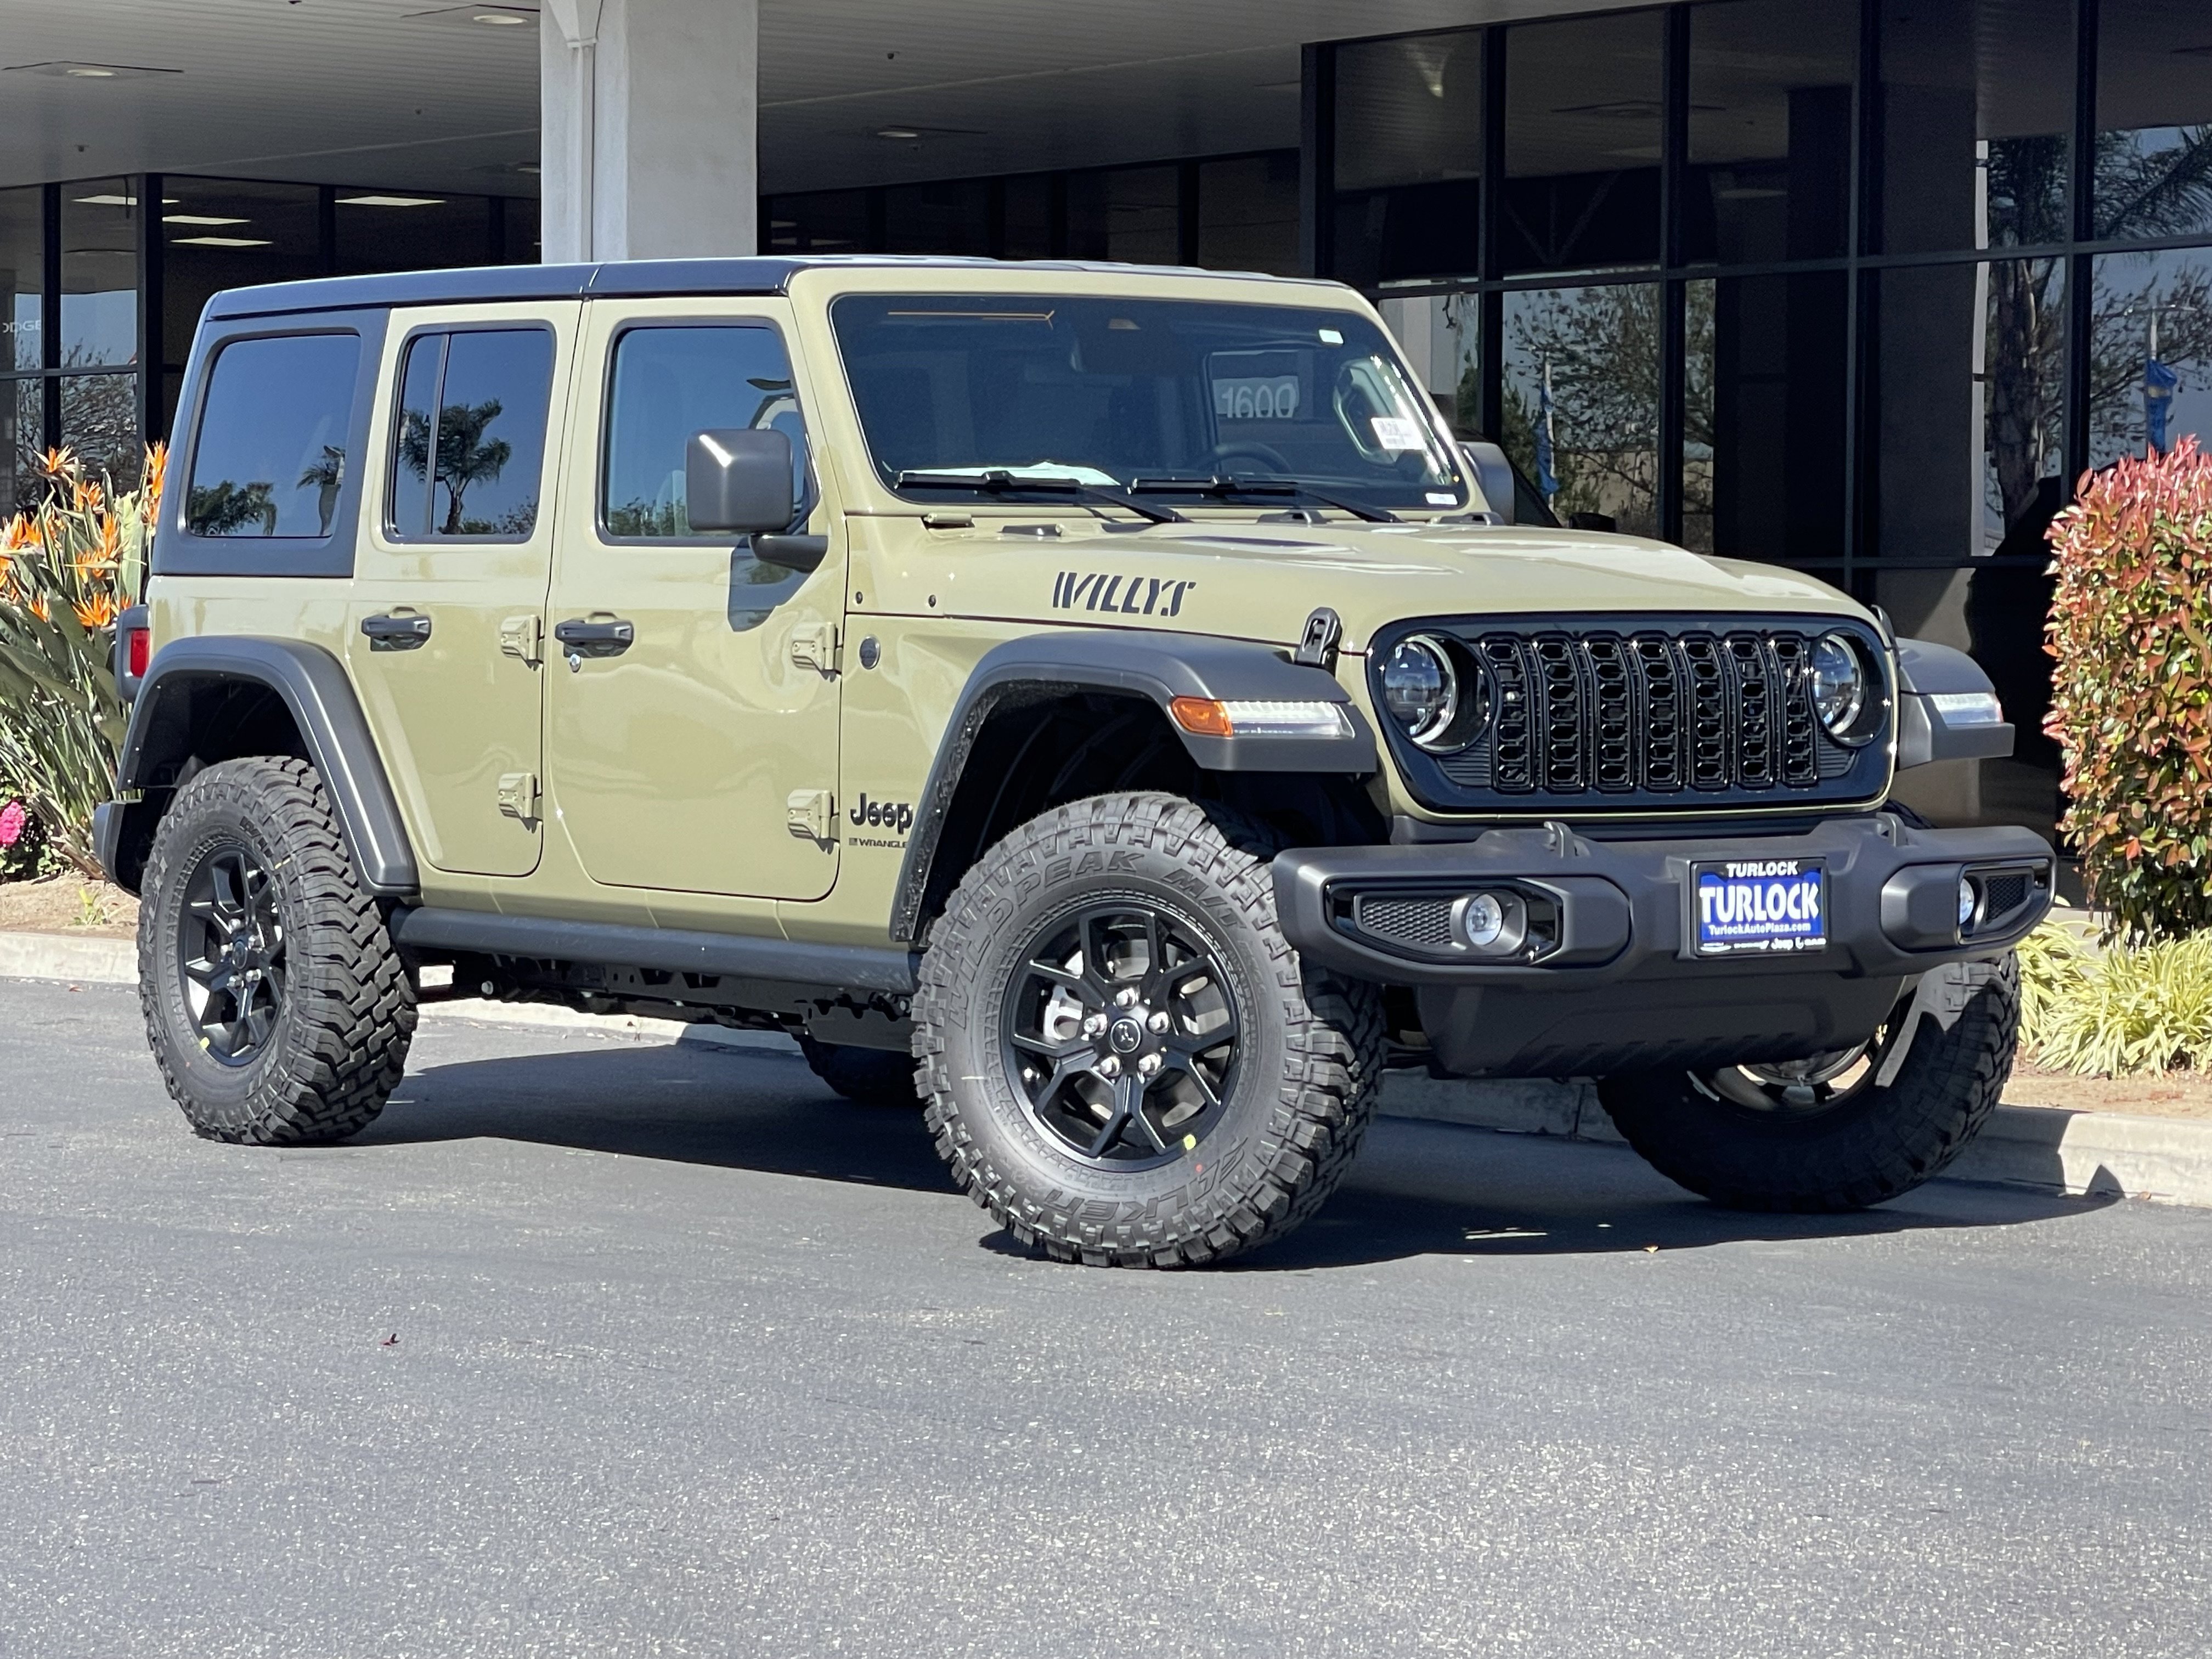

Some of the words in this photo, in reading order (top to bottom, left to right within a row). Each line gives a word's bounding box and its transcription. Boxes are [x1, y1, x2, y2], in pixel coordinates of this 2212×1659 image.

[1222, 383, 1296, 419] 1600
[1053, 572, 1197, 617] WILLYS
[850, 793, 913, 834] Jeep
[1726, 861, 1798, 877] TURLOCK
[1699, 882, 1819, 923] TURLOCK
[949, 851, 1145, 1030] WILDPEAK
[1708, 923, 1811, 935] TurlockAutoPlaza.com
